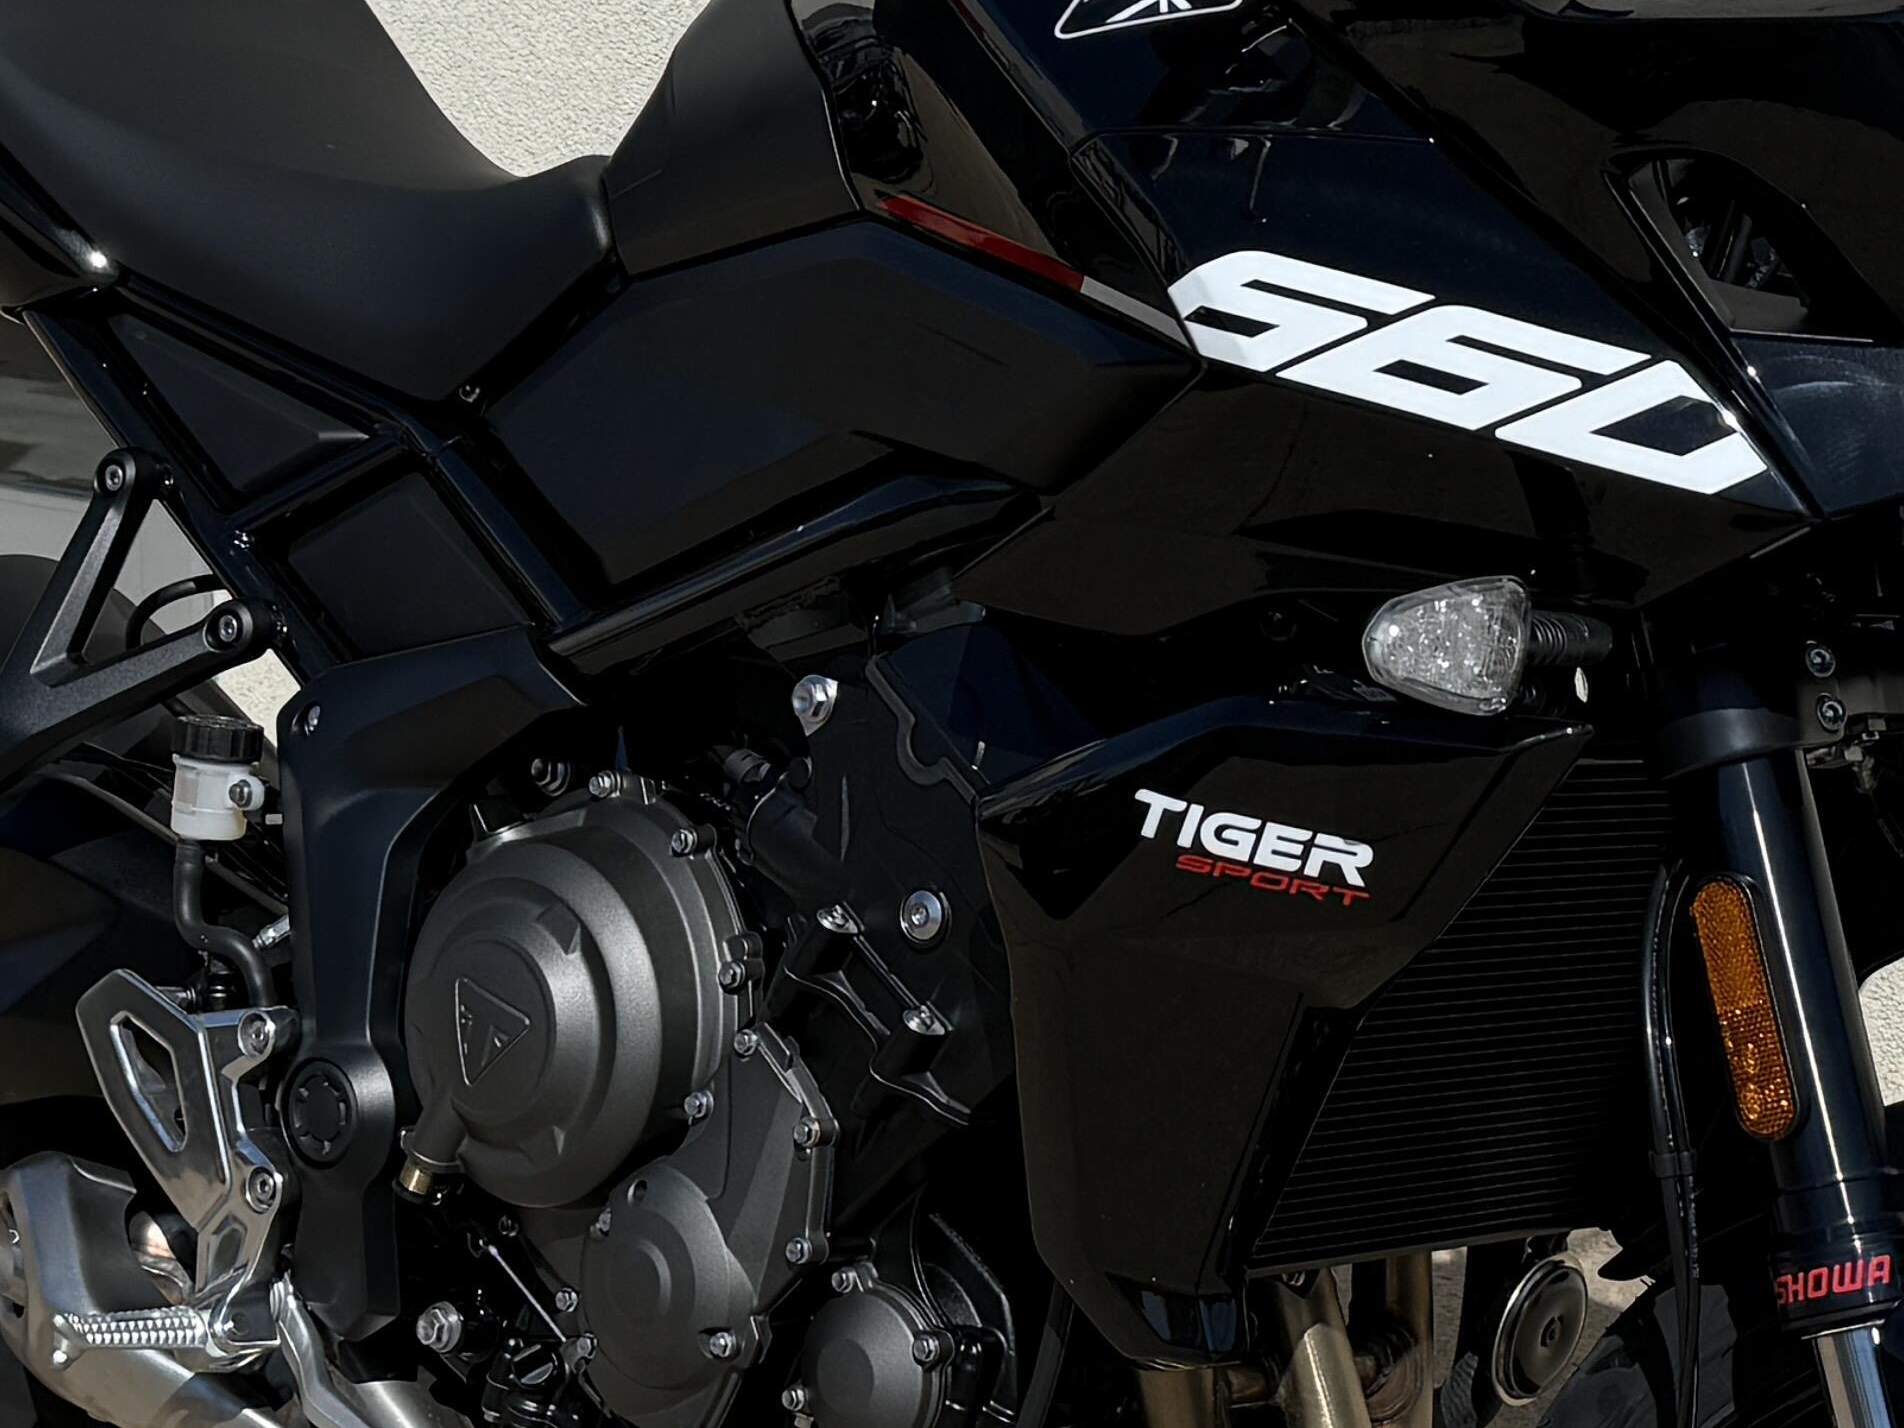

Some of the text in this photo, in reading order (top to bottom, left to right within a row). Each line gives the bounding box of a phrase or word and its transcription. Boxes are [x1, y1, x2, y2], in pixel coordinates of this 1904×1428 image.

[1168, 250, 1768, 496] 660
[1134, 788, 1374, 888] TIGER
[1176, 854, 1371, 906] SPORT
[1775, 1254, 1892, 1305] SHOWA
